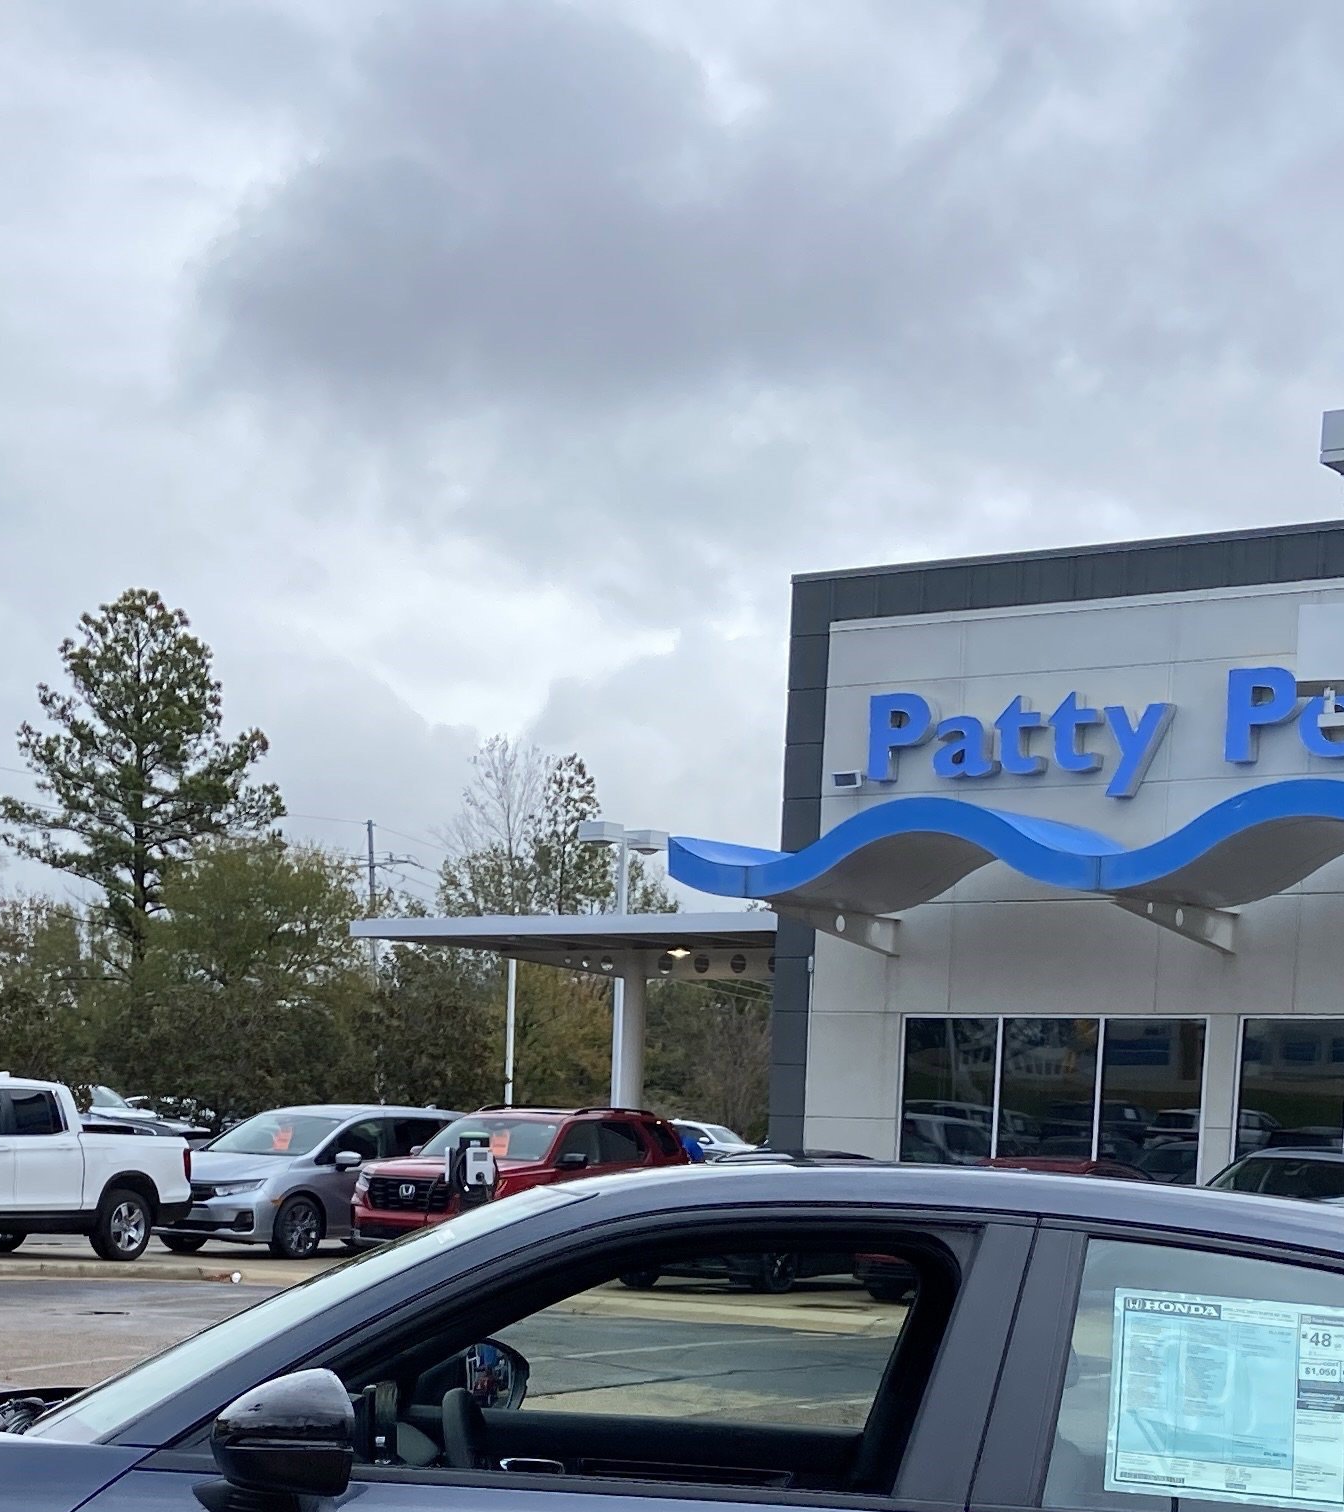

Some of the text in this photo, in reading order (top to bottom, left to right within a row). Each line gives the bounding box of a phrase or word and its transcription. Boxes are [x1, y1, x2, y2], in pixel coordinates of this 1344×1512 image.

[868, 690, 1176, 798] Patty
[1144, 1300, 1220, 1317] HONDA
[1309, 1331, 1332, 1348] 48
